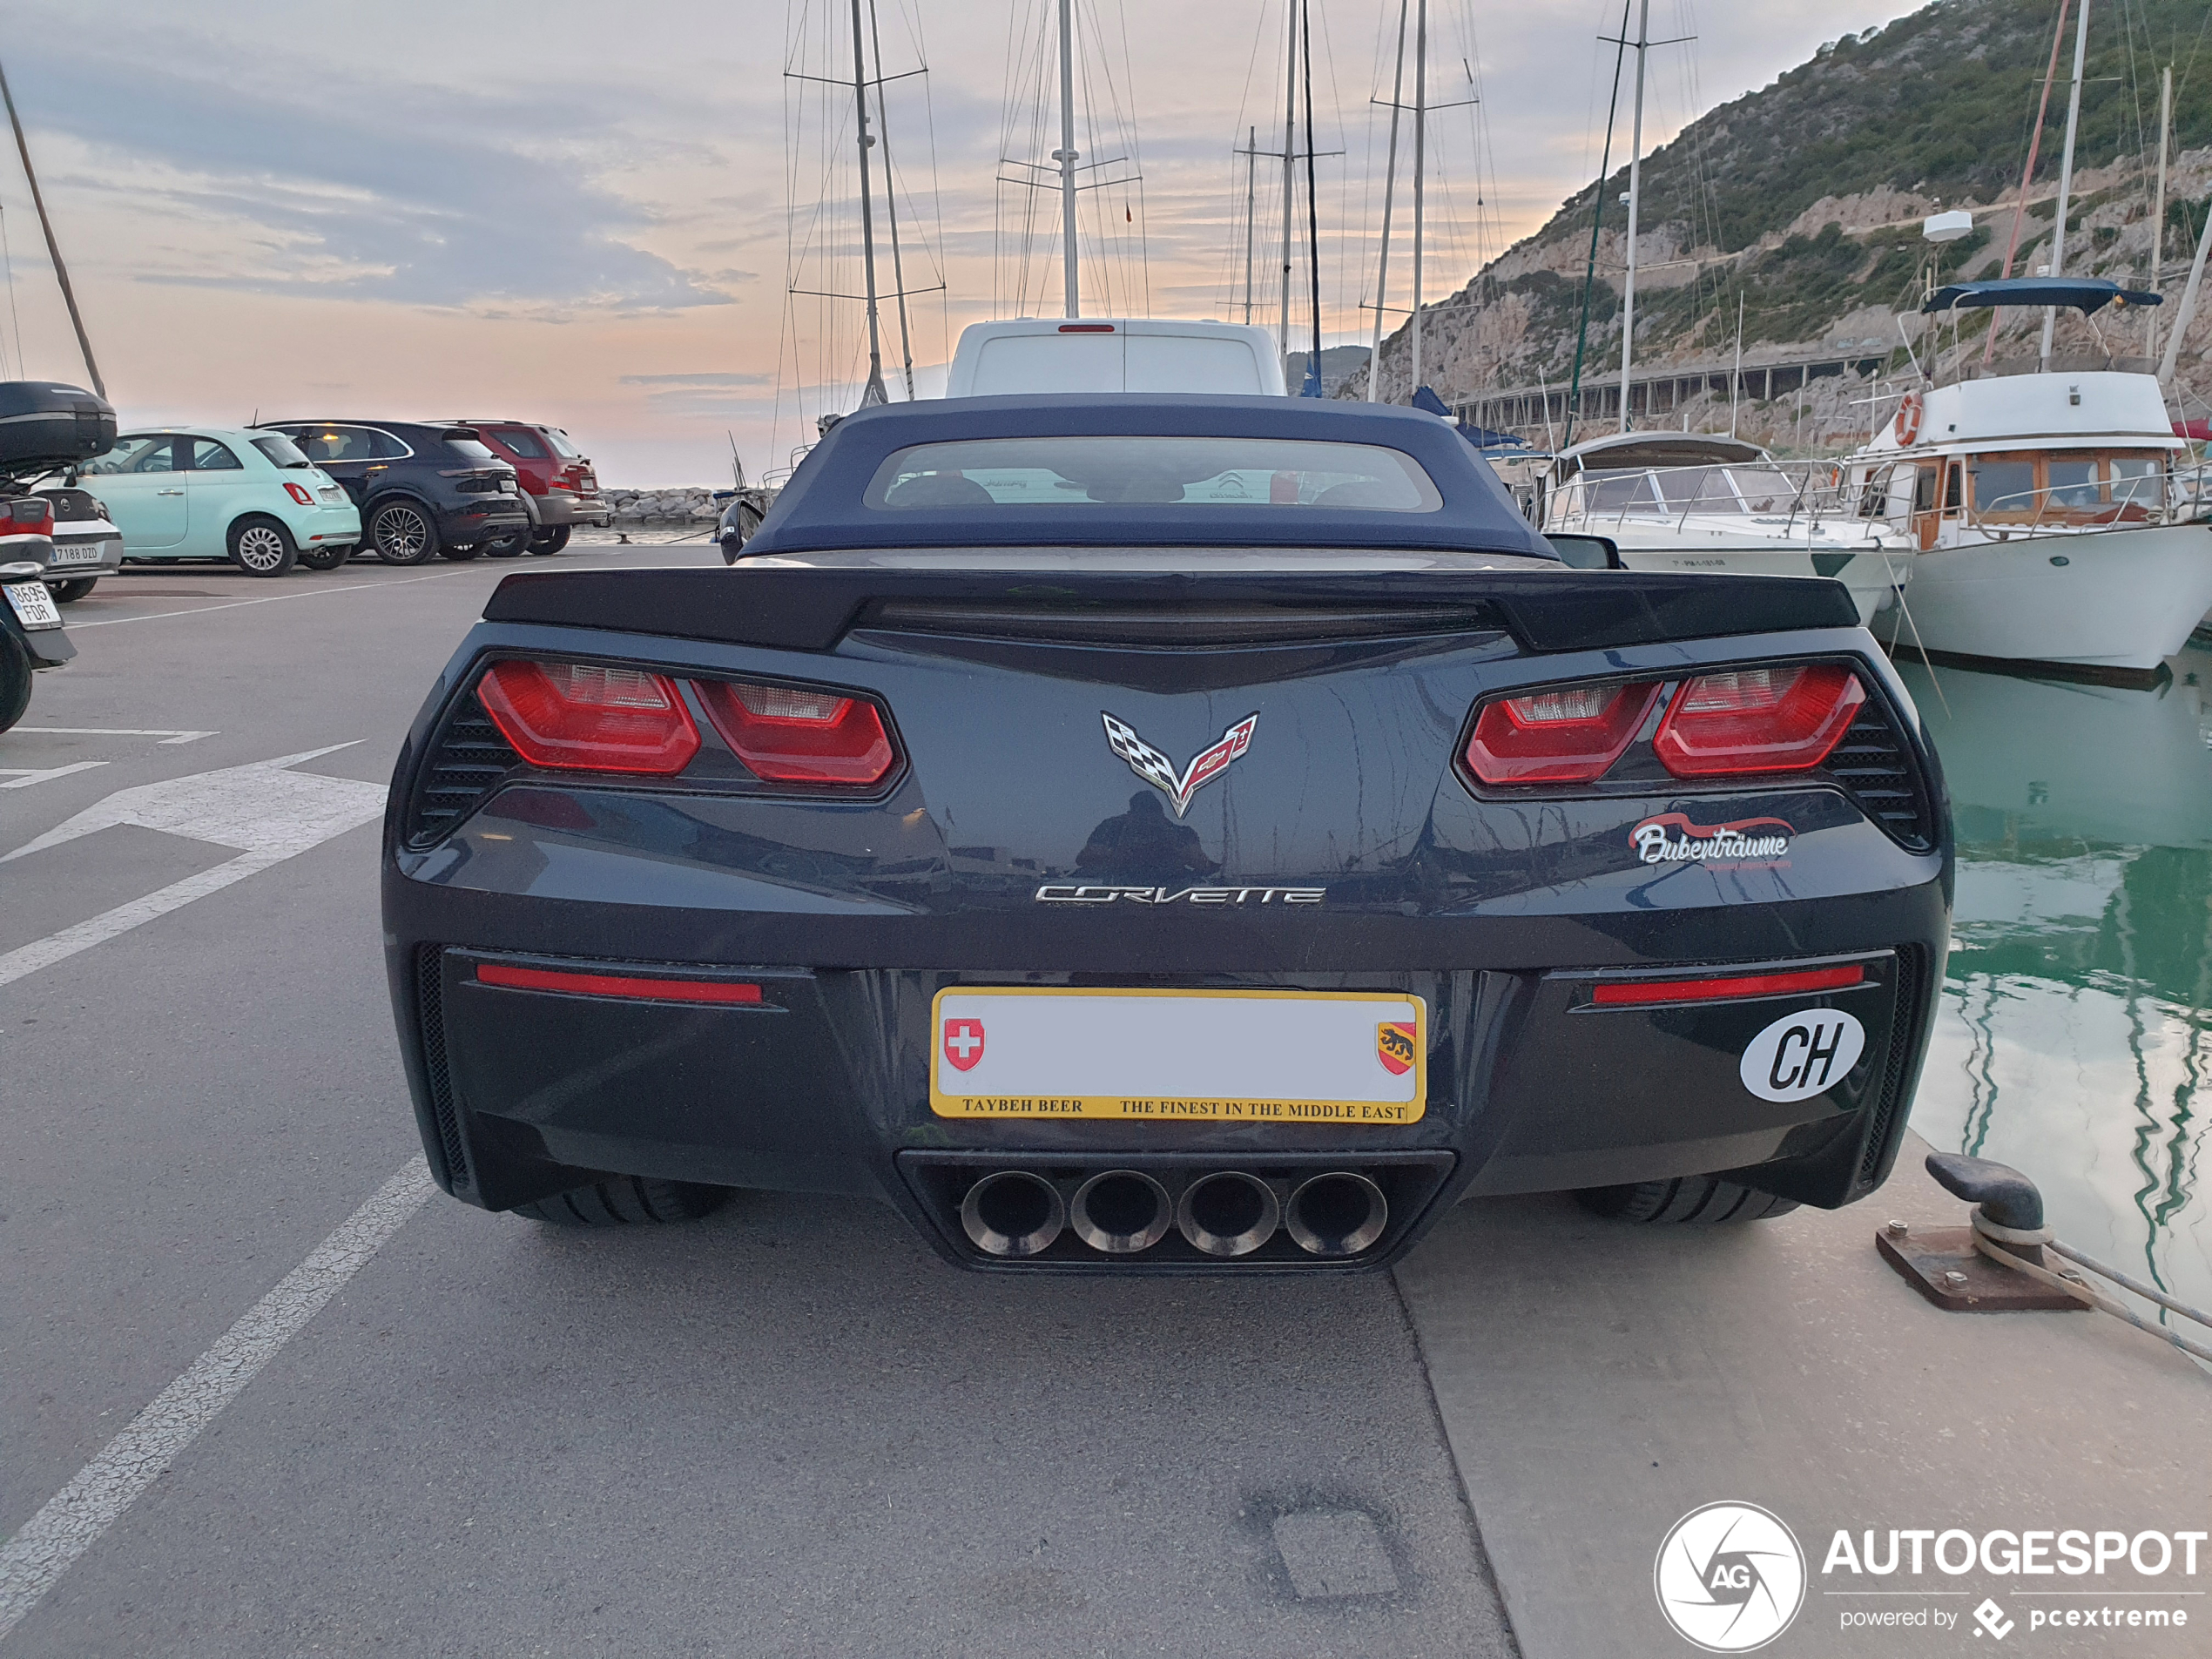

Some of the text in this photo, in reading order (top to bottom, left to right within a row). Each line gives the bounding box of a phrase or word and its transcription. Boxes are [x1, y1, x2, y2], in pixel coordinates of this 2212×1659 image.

[57, 548, 81, 561] 7188
[10, 584, 47, 603] 8695
[23, 604, 51, 621] FDR
[1635, 824, 1788, 862] Bubenträume
[1035, 885, 1326, 905] CORVETTE
[1769, 1022, 1844, 1090] CH
[962, 1098, 1406, 1120] TAYBEH BEER THE FINEST IN THE MIDDLE EAST
